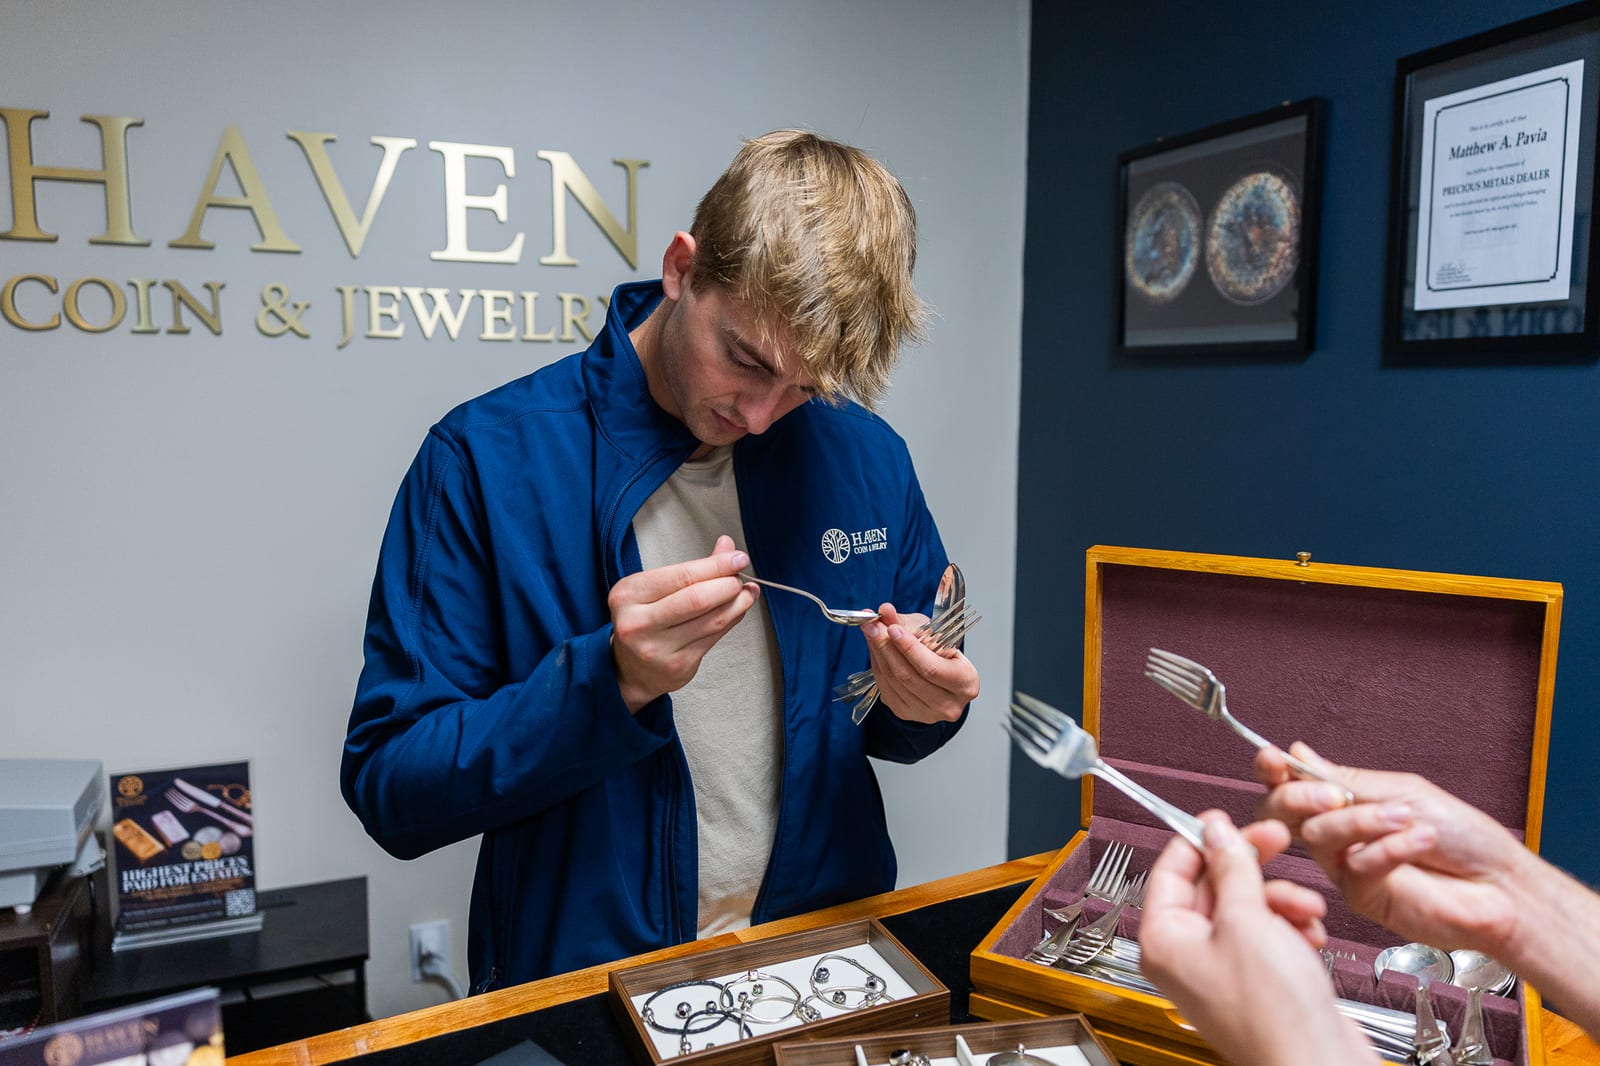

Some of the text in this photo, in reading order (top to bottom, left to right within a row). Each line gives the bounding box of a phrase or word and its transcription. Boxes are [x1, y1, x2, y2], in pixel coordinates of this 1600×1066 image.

[1448, 128, 1548, 160] Matthew A. Pavia
[0, 108, 650, 270] HAVEN
[1442, 181, 1482, 197] PRECIOUS
[1483, 175, 1516, 190] METALS
[1516, 168, 1551, 184] DEALER
[0, 274, 226, 336] COIN
[257, 283, 311, 340] &
[122, 855, 249, 881] HIGHEST PRICES
[122, 877, 158, 893] PAID
[159, 872, 190, 888] FOR
